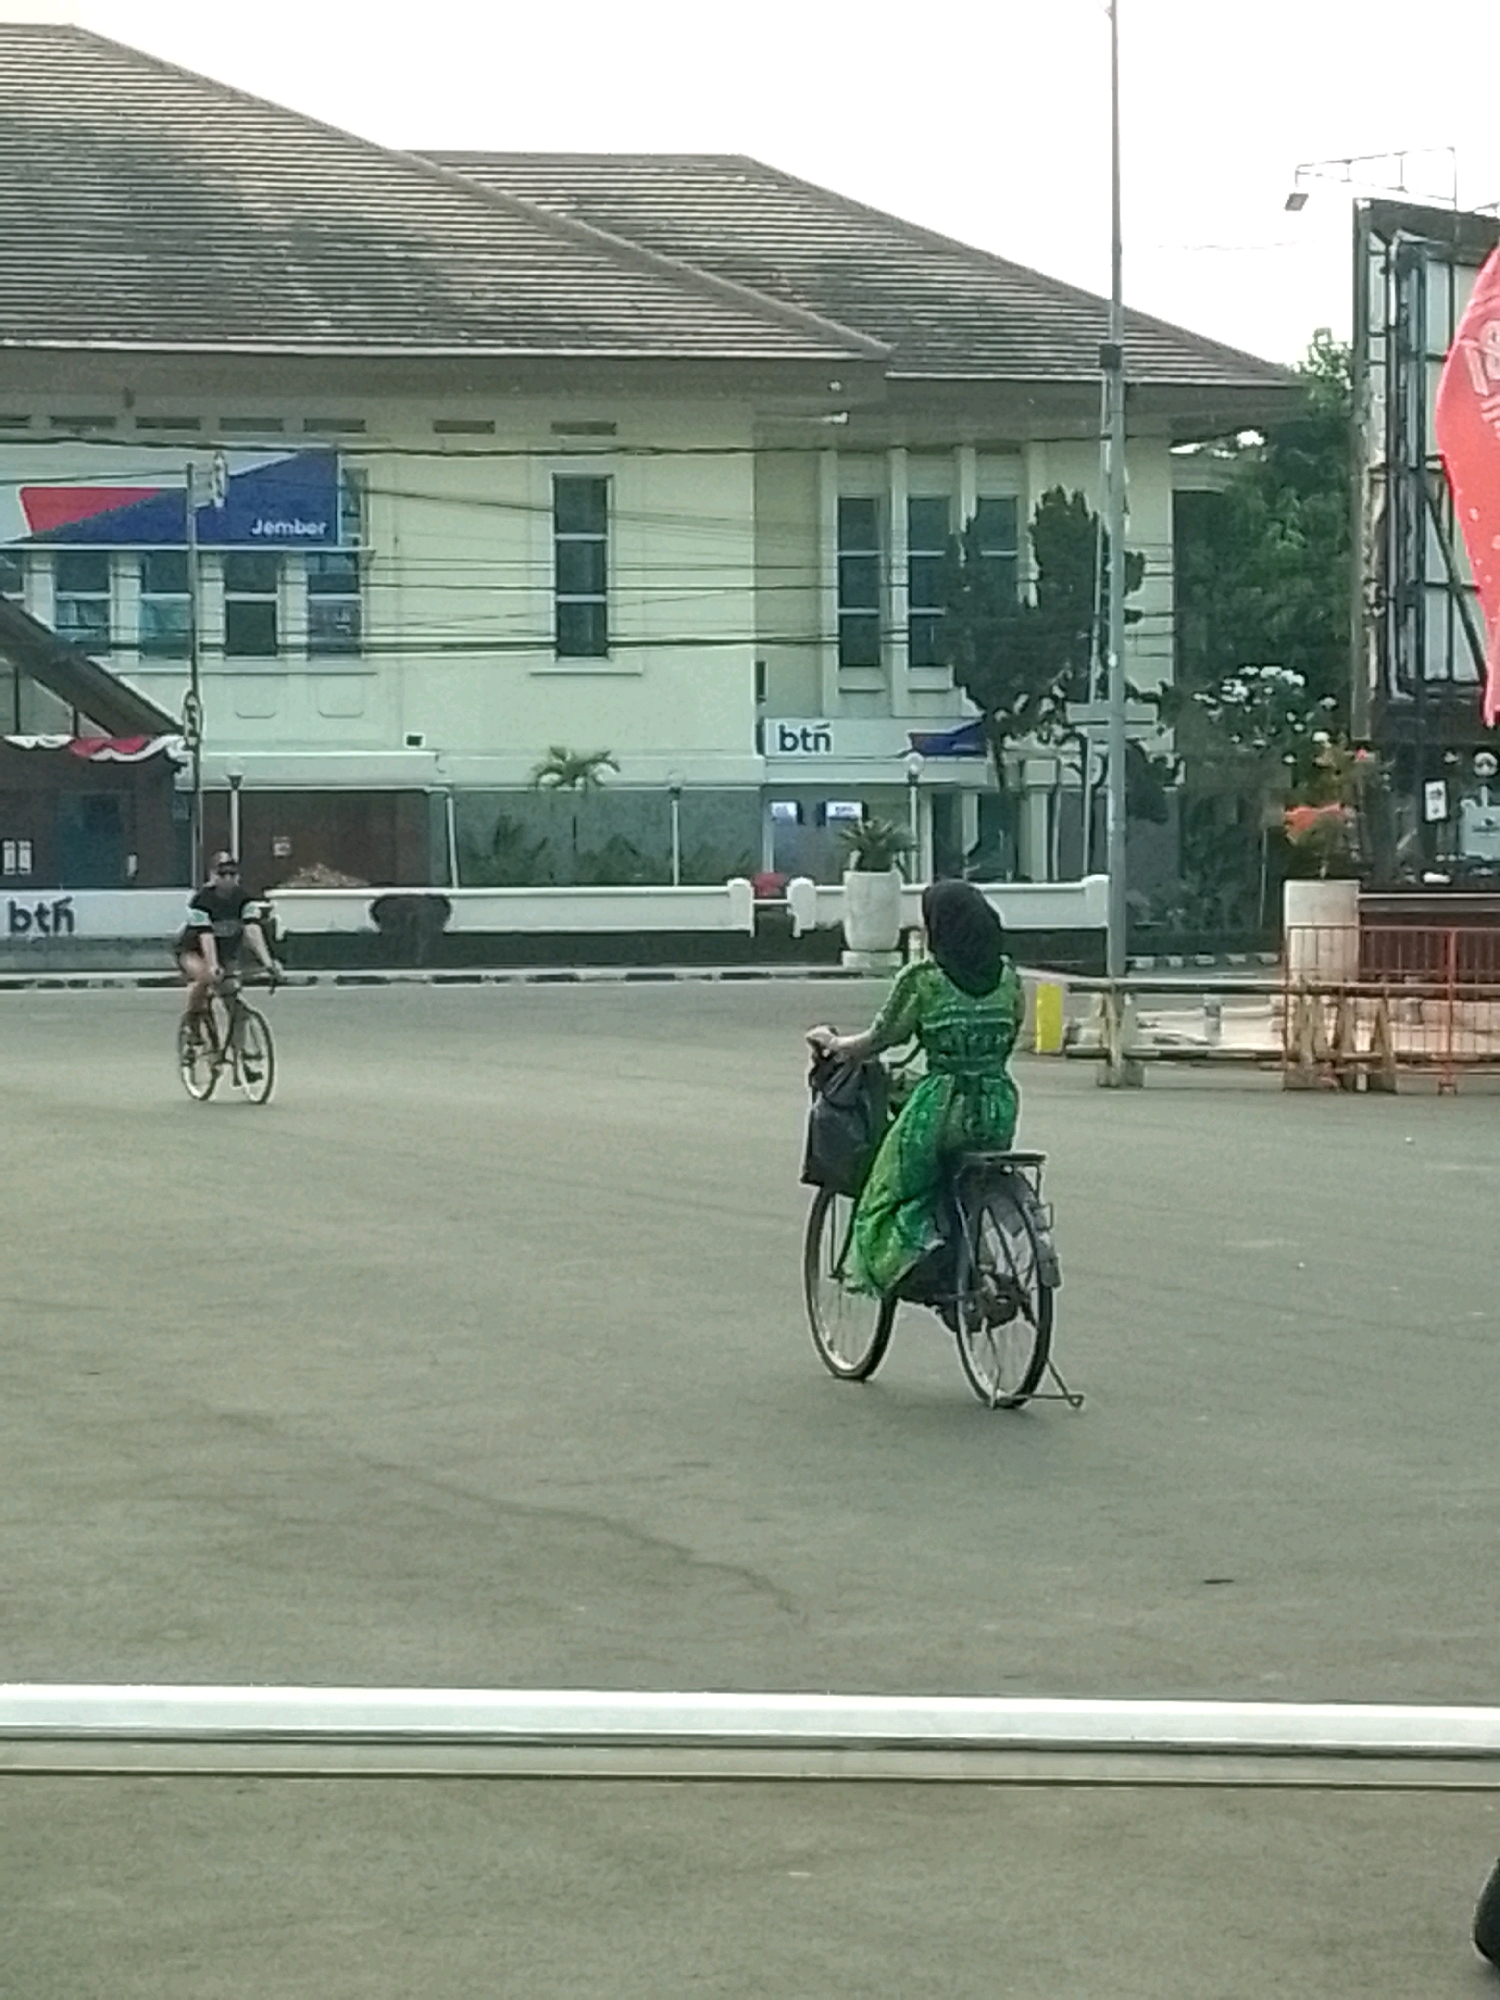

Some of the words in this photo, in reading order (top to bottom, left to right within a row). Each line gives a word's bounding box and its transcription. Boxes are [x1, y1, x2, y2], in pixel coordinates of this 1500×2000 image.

[251, 518, 327, 535] Jember
[778, 722, 831, 752] btn
[9, 896, 75, 934] btn
